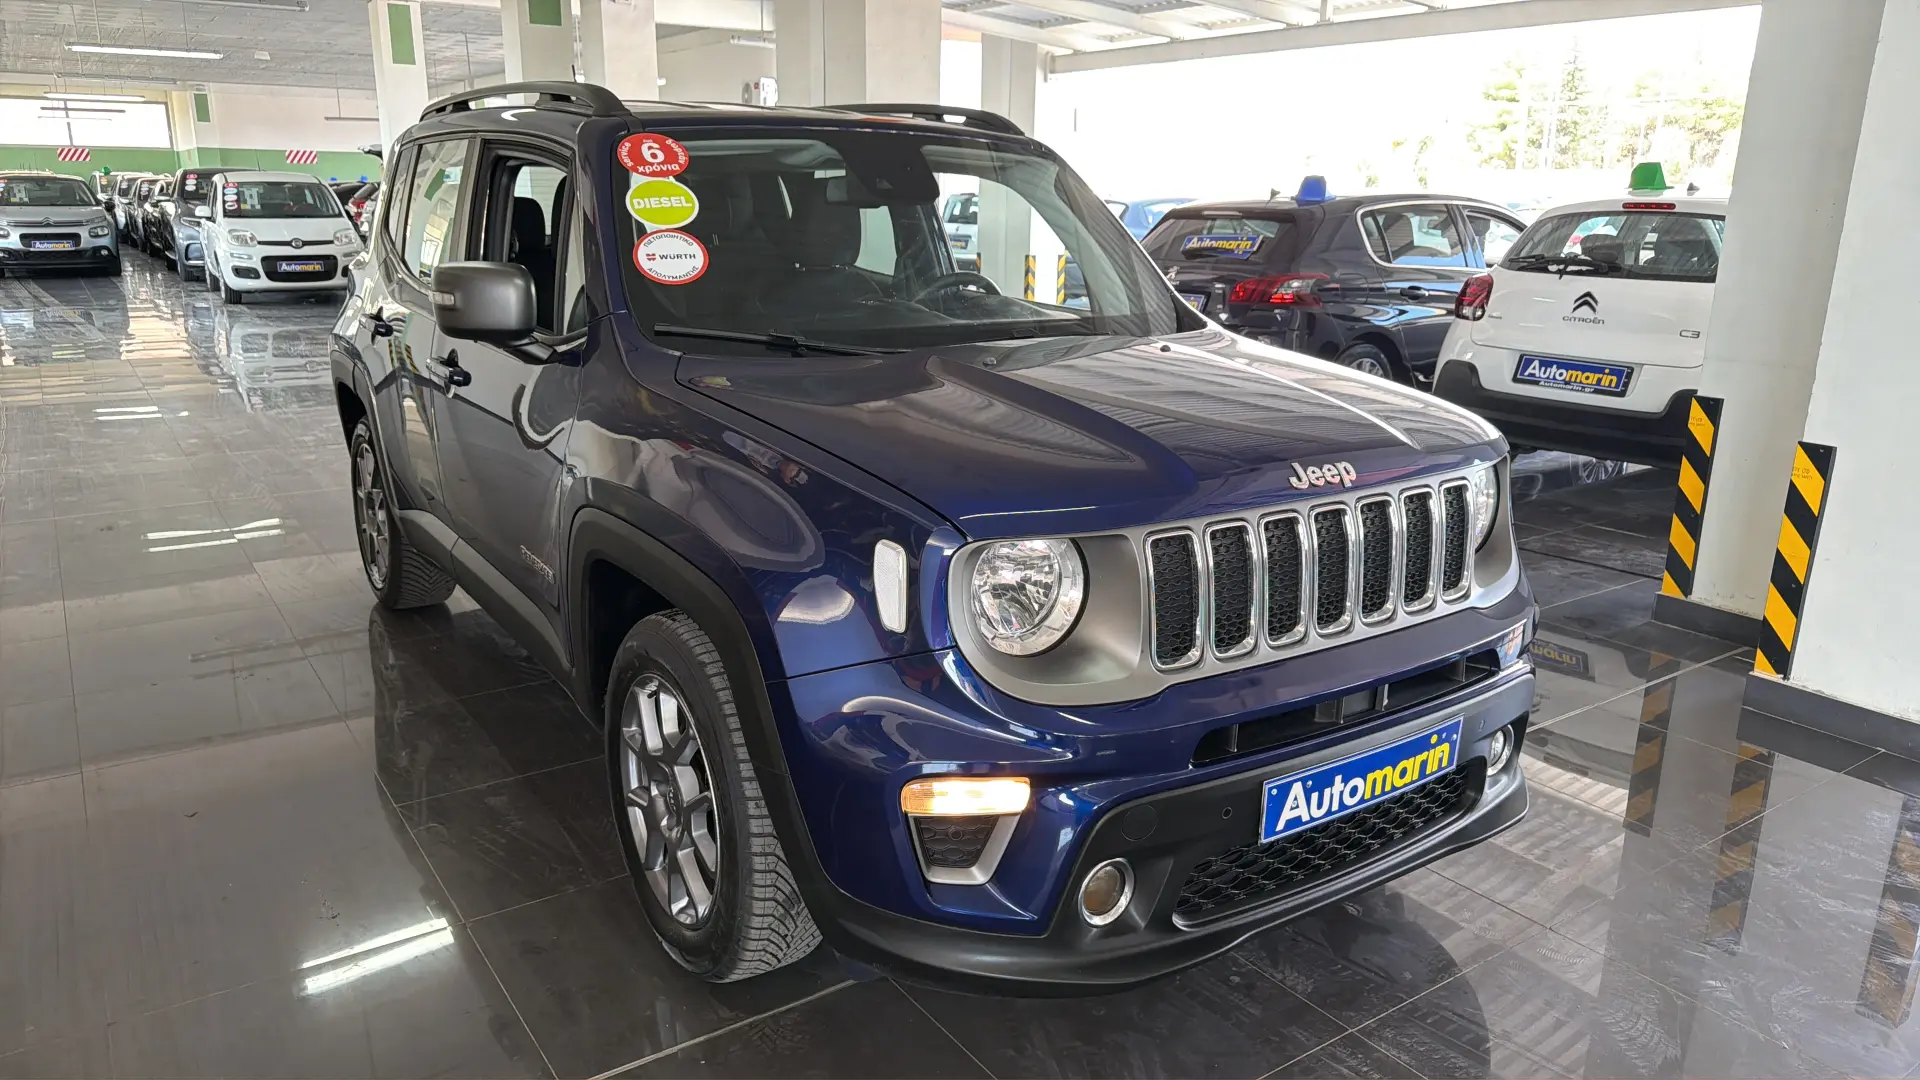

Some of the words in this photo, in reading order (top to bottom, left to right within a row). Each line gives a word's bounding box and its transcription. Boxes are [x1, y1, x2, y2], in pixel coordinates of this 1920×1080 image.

[621, 142, 634, 167] service
[641, 142, 665, 163] 6
[637, 164, 680, 174] χρόνια
[632, 197, 693, 210] DIESEL
[35, 241, 70, 249] Automarin
[281, 262, 321, 272] Automarin
[647, 265, 700, 280] ΑΠΟΛΥΜΑΝΣΗΣ
[1679, 329, 1701, 339] C3
[1524, 359, 1617, 389] Automarin
[1539, 381, 1595, 393] Automarin.gr
[1288, 461, 1357, 489] Jeep
[1275, 734, 1450, 831] Automarin
